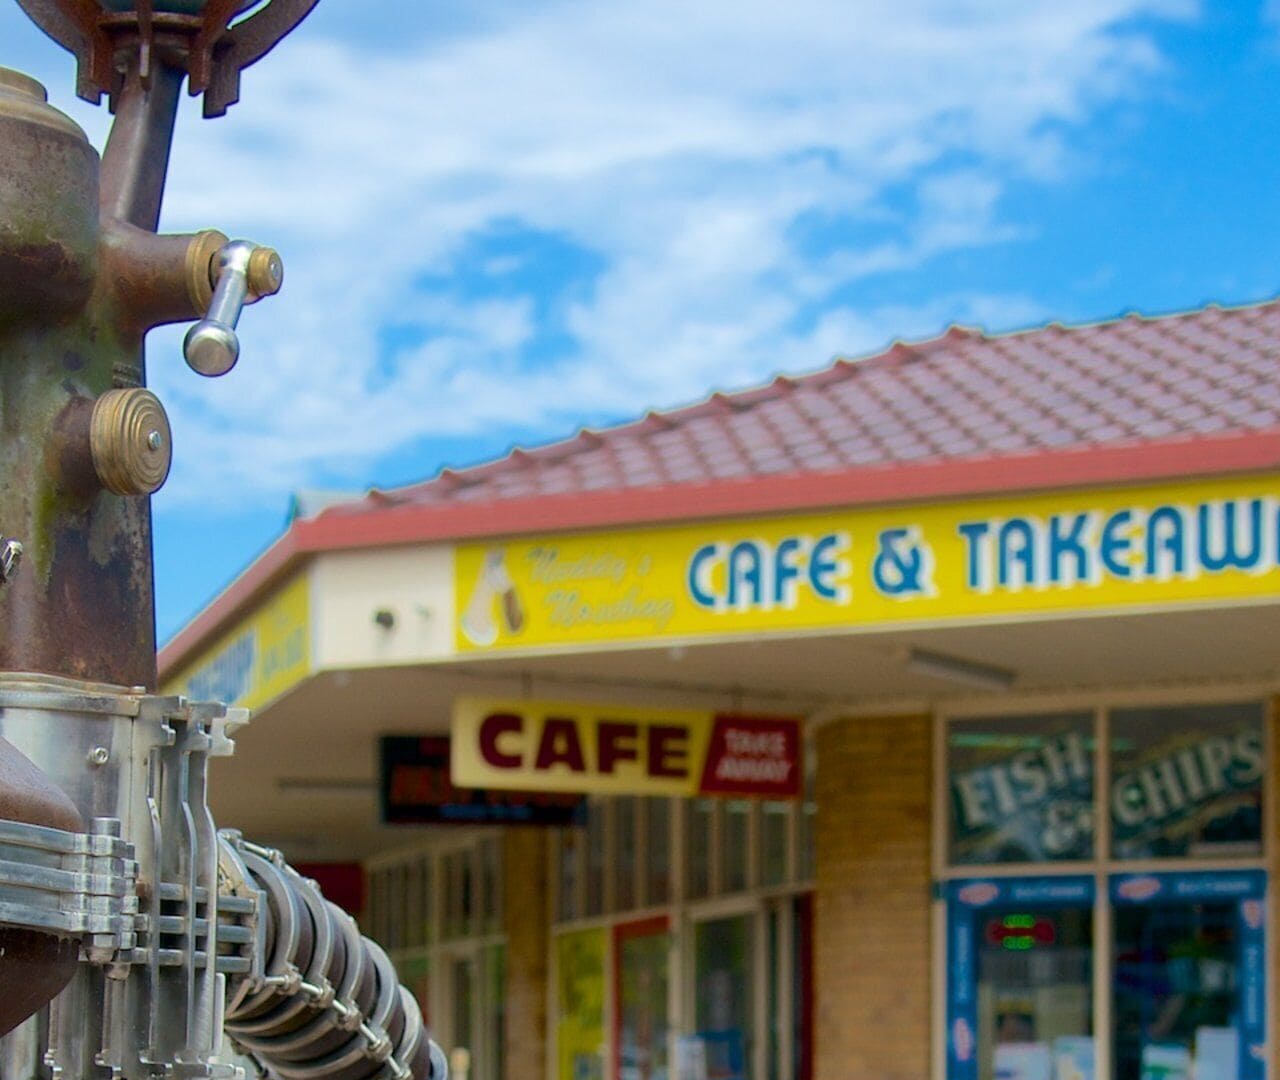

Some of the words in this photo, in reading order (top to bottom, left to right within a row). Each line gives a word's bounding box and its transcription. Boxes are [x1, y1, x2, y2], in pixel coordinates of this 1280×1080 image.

[687, 532, 846, 609] CAFE
[873, 526, 932, 598] &
[477, 711, 690, 780] CAFE
[714, 755, 793, 784] AWAY
[722, 726, 788, 757] TAKE
[955, 731, 1090, 827] FISH
[1112, 729, 1265, 827] CHIPS
